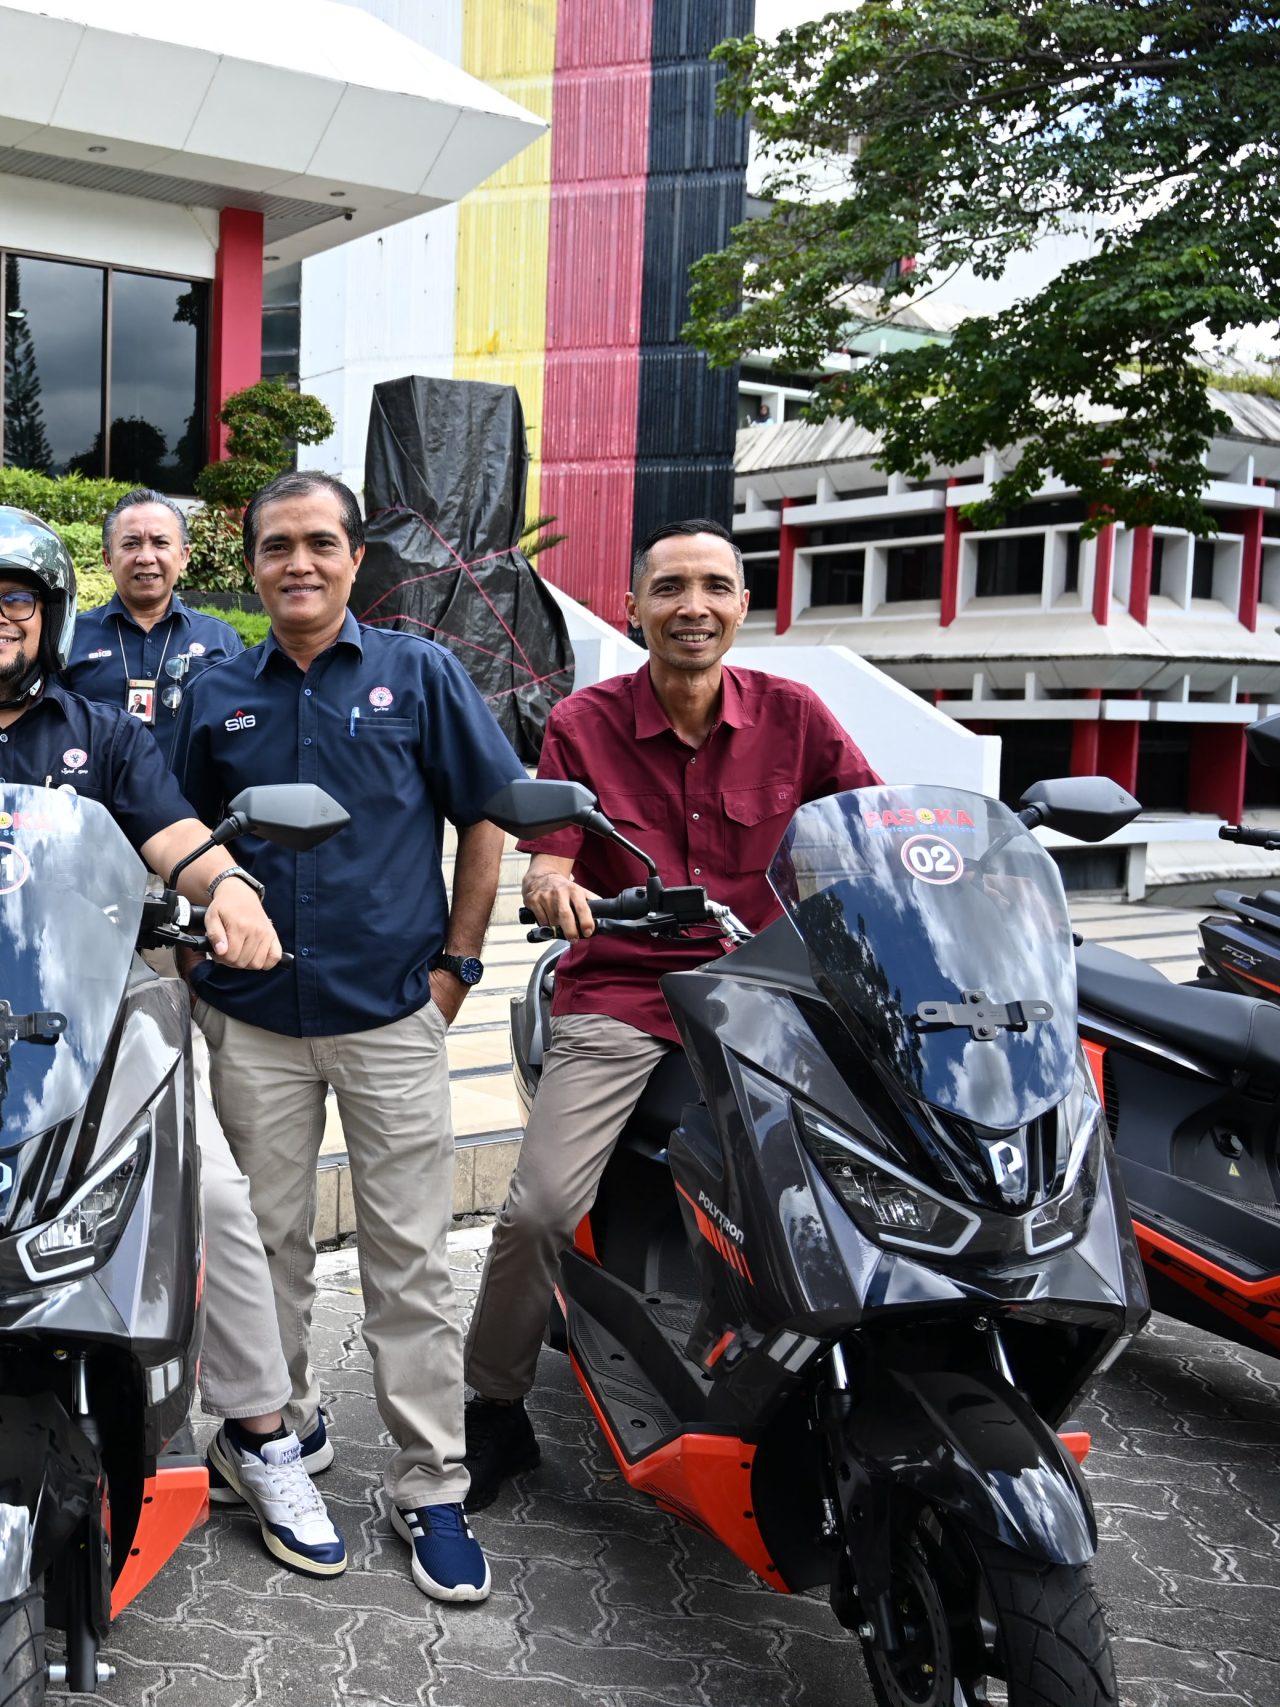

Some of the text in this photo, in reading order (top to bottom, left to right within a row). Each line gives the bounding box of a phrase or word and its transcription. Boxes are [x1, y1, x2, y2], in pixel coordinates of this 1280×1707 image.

[224, 714, 256, 732] SIG
[908, 845, 956, 873] 02
[699, 1189, 745, 1244] POLYTRON
